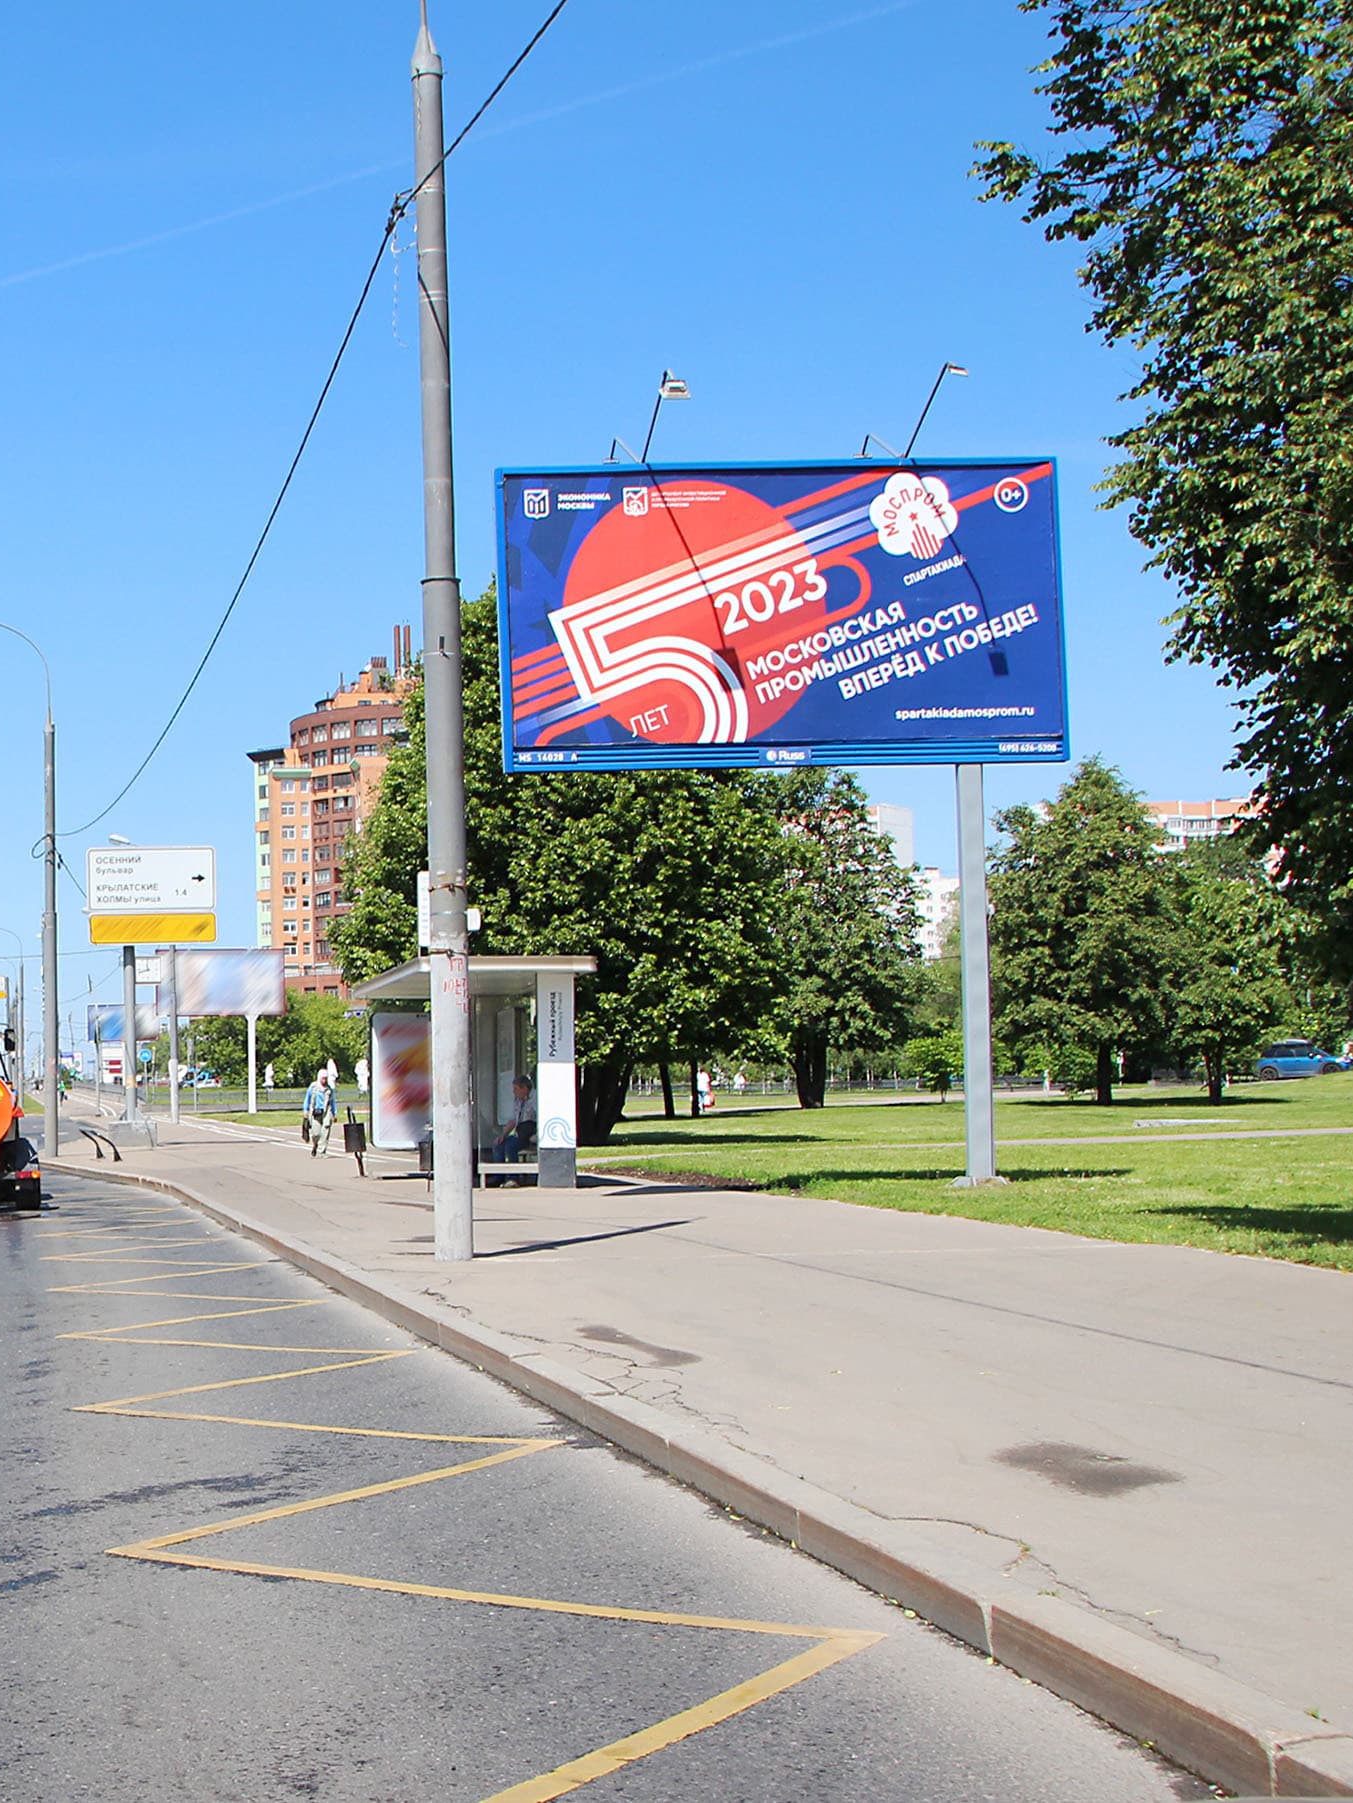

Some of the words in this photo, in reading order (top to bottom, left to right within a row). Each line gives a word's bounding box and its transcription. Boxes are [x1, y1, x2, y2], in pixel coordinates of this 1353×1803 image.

[557, 492, 611, 502] ЭКОНОМИКА
[1000, 488, 1022, 503] 0+
[557, 502, 595, 510] МОСКВЫ
[883, 487, 947, 537] МОСПРОМ
[902, 554, 966, 587] СПАРТАКИАДА
[714, 558, 828, 636] 2023
[745, 600, 906, 681] МОСКОВСКАЯ
[754, 601, 980, 704] ПРОМЫШЛЕННОСТЬ
[837, 653, 926, 700] ВПЕРЁД
[925, 644, 946, 665] К
[946, 603, 1040, 659] ПОБЕДЕ!
[895, 705, 1035, 721] spartakiadamosprom.ru
[629, 704, 669, 738] ЛЕТ
[778, 750, 806, 761] Russ
[95, 856, 142, 865] ОСЕННИЙ
[95, 866, 134, 876] бульвар
[96, 882, 159, 892] КРЫЛАТСКИЕ
[96, 895, 132, 904] ХОЛМЫ
